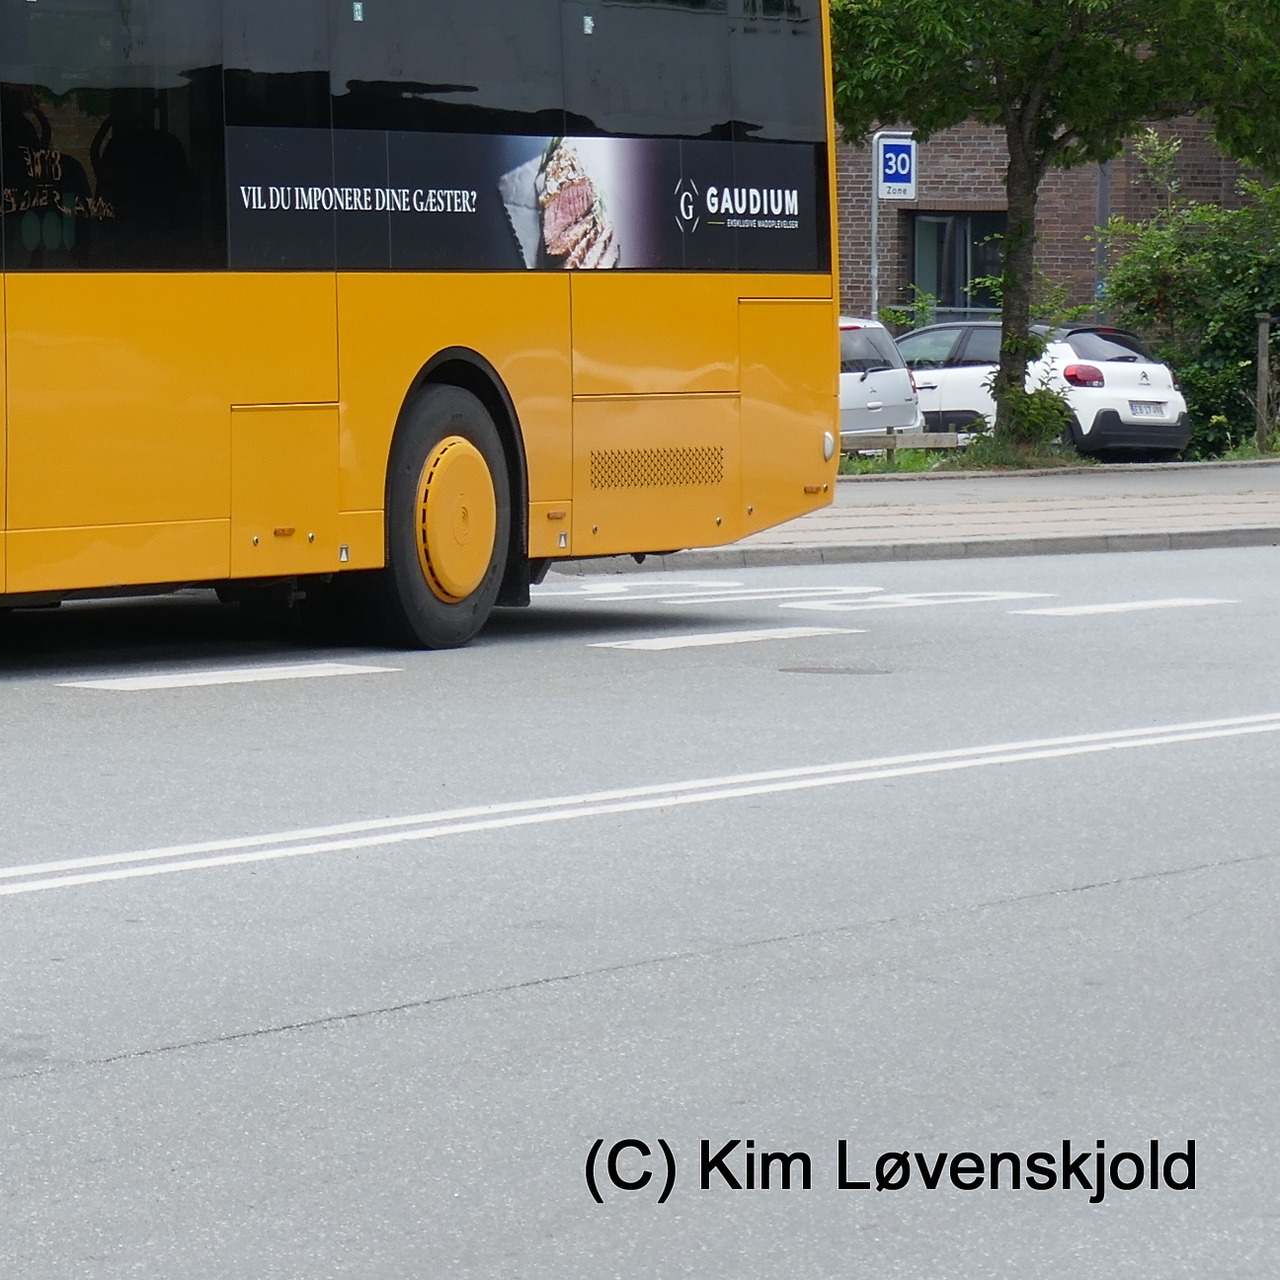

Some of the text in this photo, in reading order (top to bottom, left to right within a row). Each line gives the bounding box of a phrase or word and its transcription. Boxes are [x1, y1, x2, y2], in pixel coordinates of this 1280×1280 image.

[884, 152, 910, 175] 30
[239, 186, 478, 213] VIL DU IMPONERE DINE GÆSTER?
[706, 186, 799, 215] GAUDIUM
[886, 186, 908, 195] Zone
